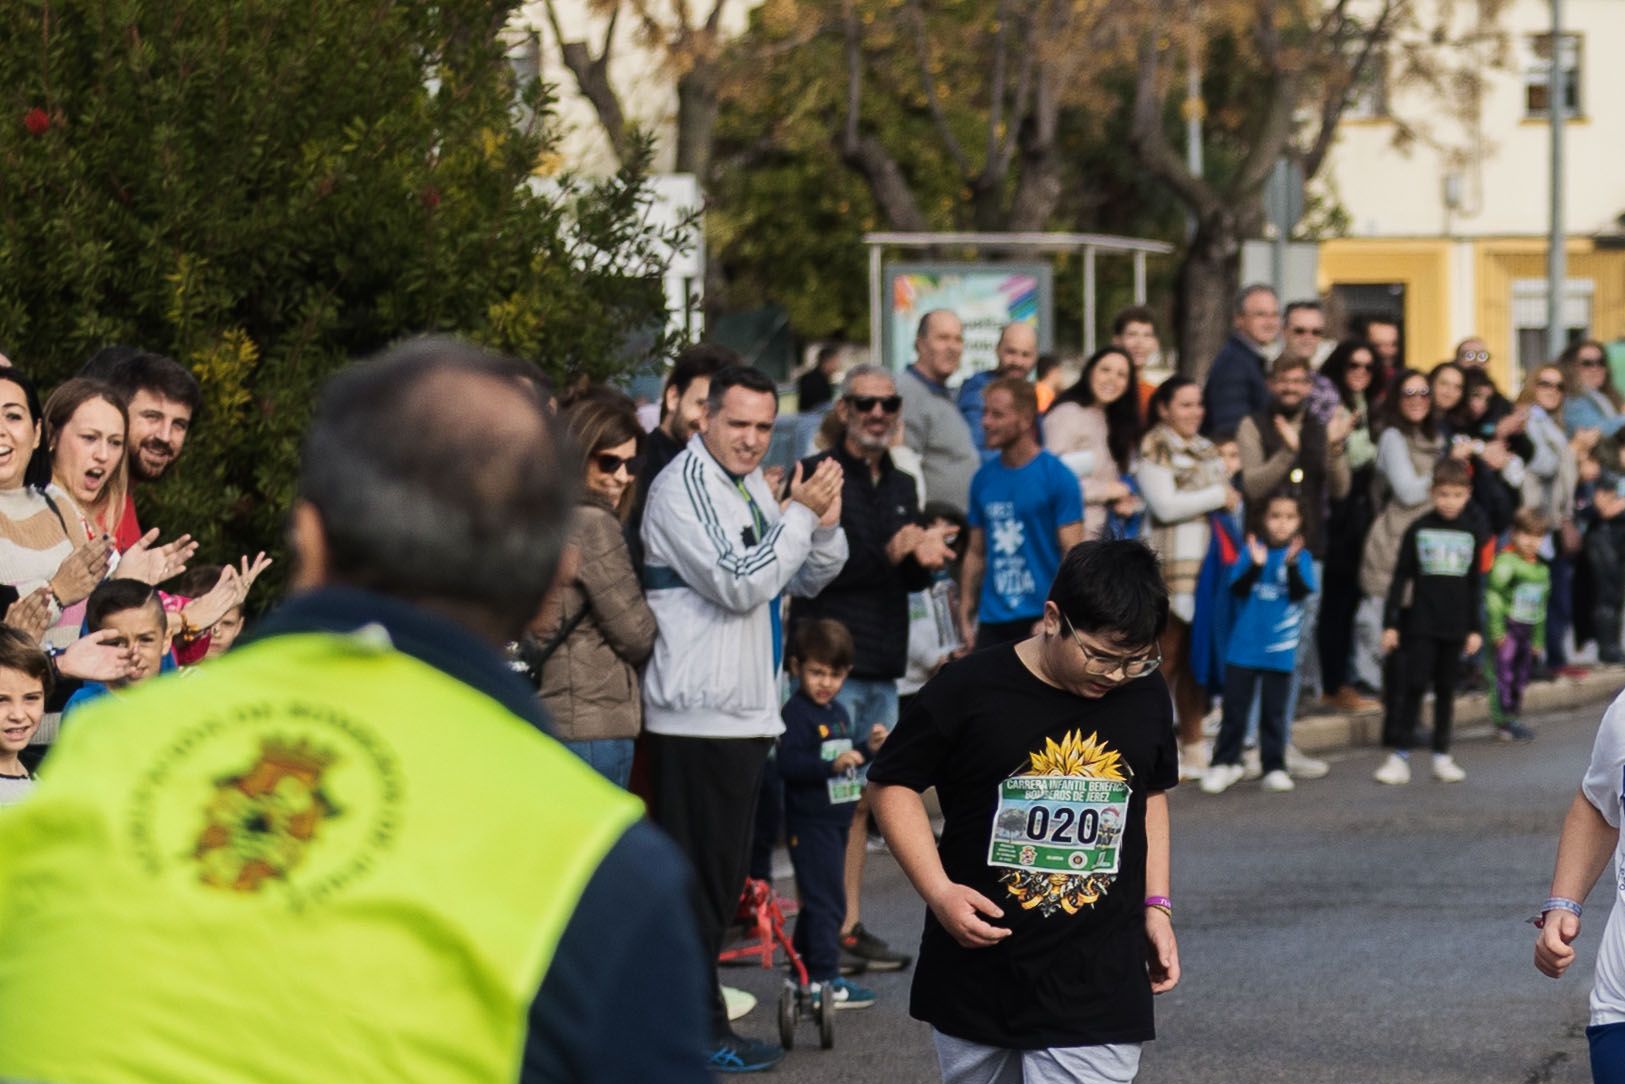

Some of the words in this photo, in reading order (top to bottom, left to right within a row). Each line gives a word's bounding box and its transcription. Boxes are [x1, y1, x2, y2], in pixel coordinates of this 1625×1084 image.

[1007, 778, 1047, 791] CARRERA
[1048, 779, 1087, 792] INFANTIL
[1024, 789, 1071, 801] BOEROS
[1073, 791, 1084, 802] DE
[1086, 791, 1110, 803] JEREZ
[1026, 805, 1099, 845] 020
